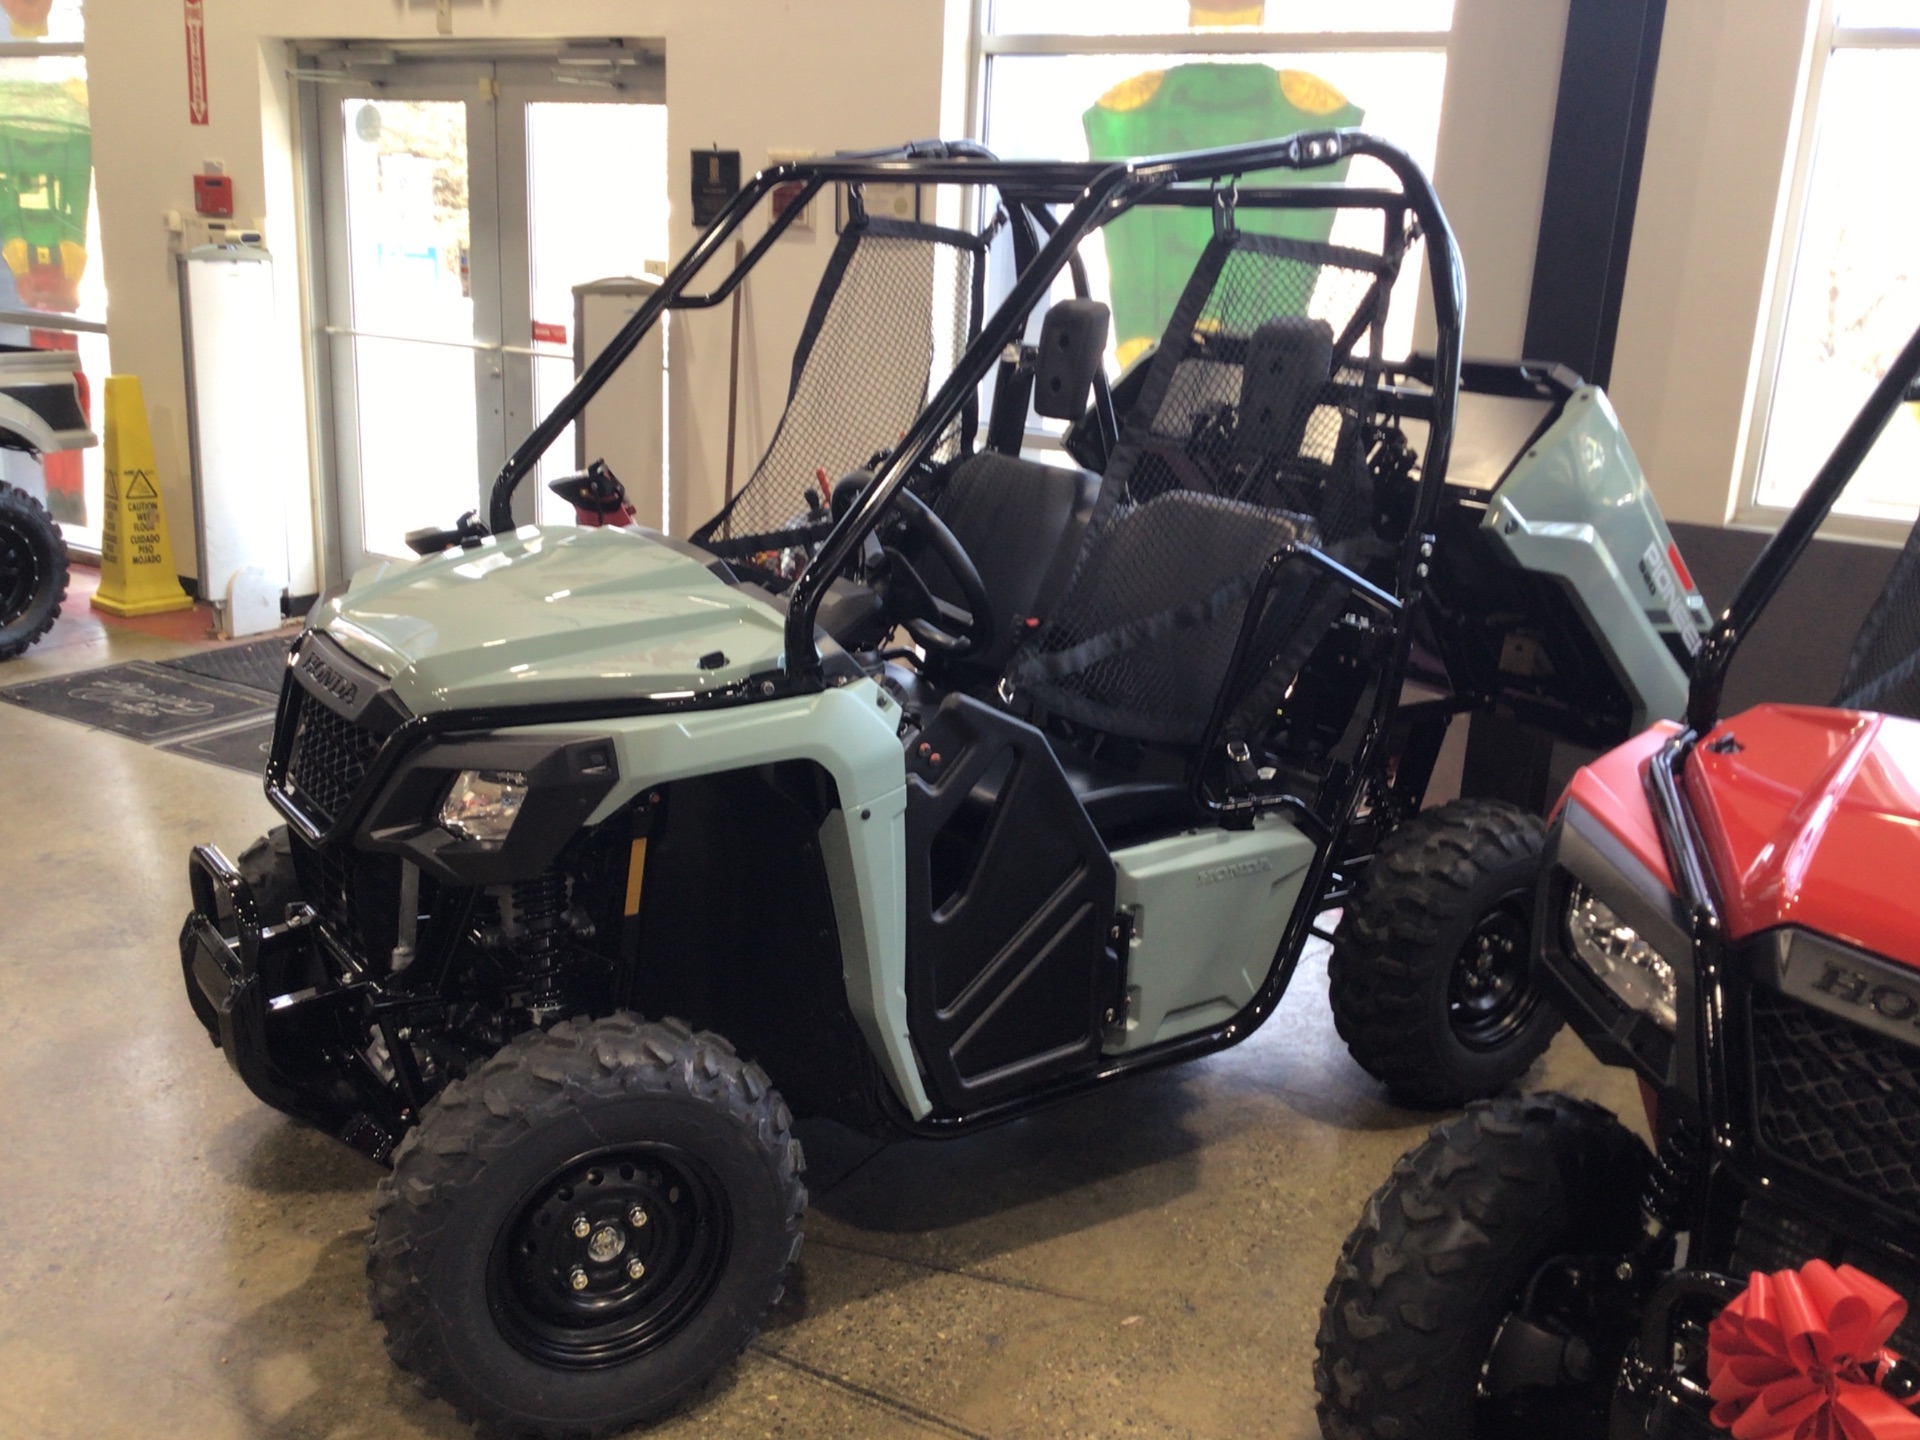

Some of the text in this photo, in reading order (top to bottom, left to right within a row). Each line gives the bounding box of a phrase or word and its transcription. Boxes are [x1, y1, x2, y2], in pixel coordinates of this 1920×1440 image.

[128, 502, 158, 512] CAUTION
[133, 523, 155, 532] FLOOR
[130, 534, 160, 545] CUIDADO
[138, 545, 154, 554] PISO
[132, 555, 162, 565] MOJADO
[302, 652, 359, 705] HONDA
[1197, 857, 1273, 887] HONDA
